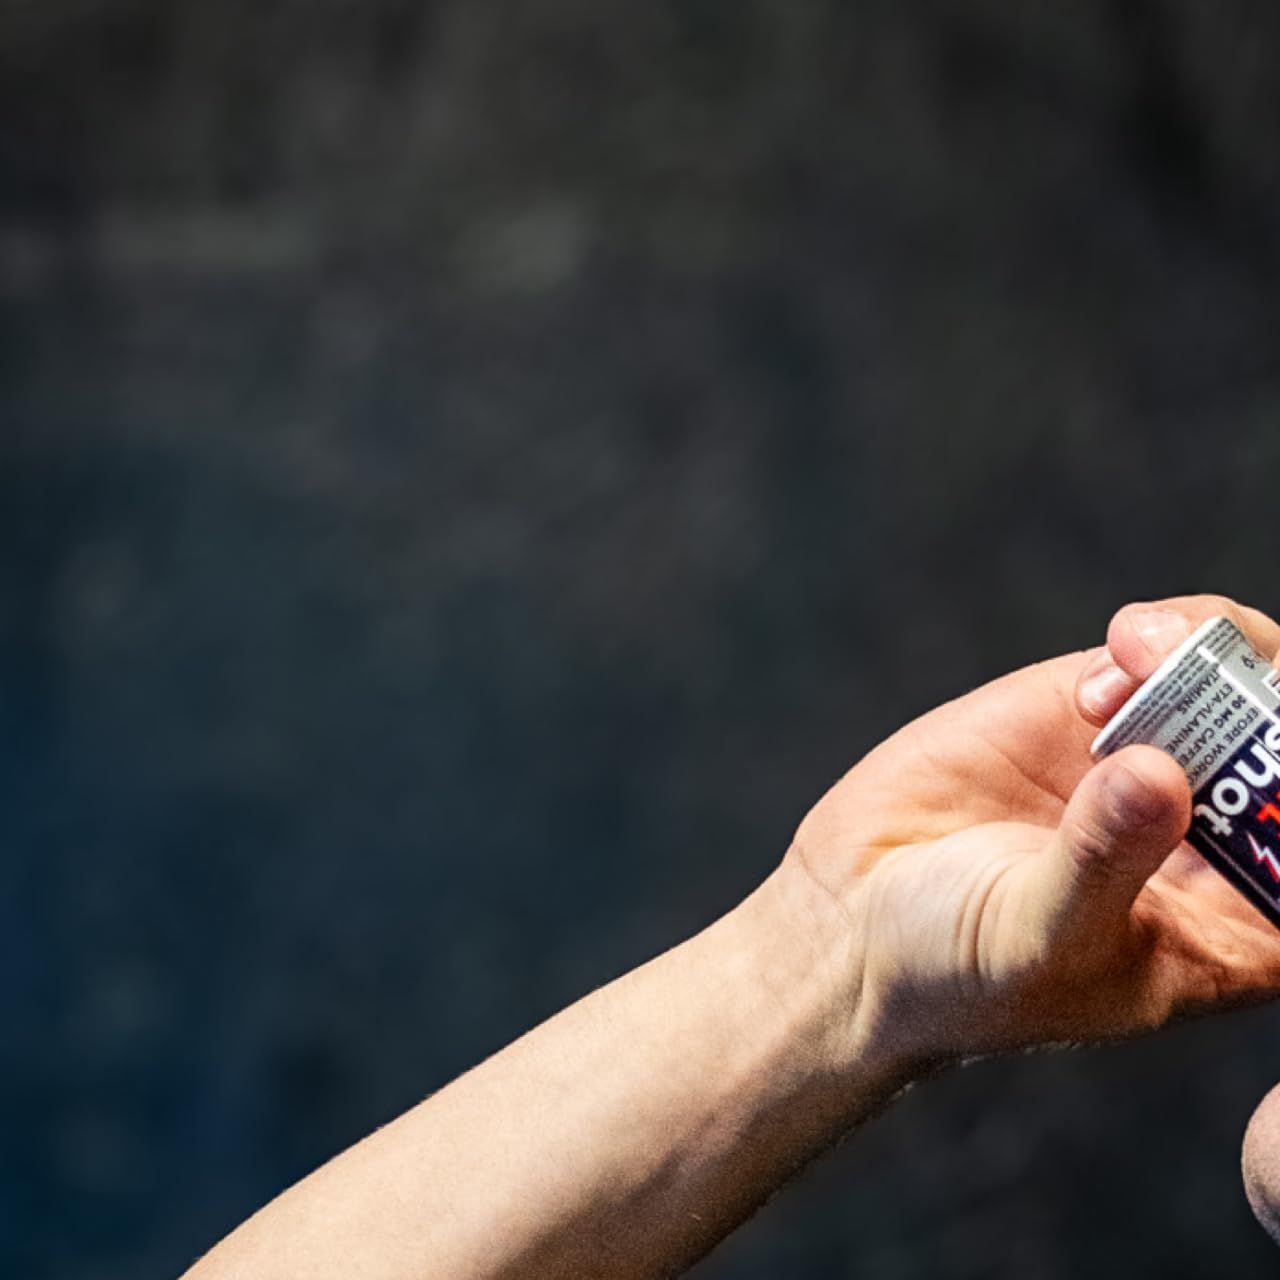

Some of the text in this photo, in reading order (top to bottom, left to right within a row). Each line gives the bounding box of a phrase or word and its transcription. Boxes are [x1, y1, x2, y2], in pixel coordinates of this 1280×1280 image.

[1178, 667, 1220, 715] ITAMINS
[1165, 683, 1233, 754] ETA-ALANINE
[1213, 707, 1233, 728] MG
[1223, 706, 1260, 744] EFORE
